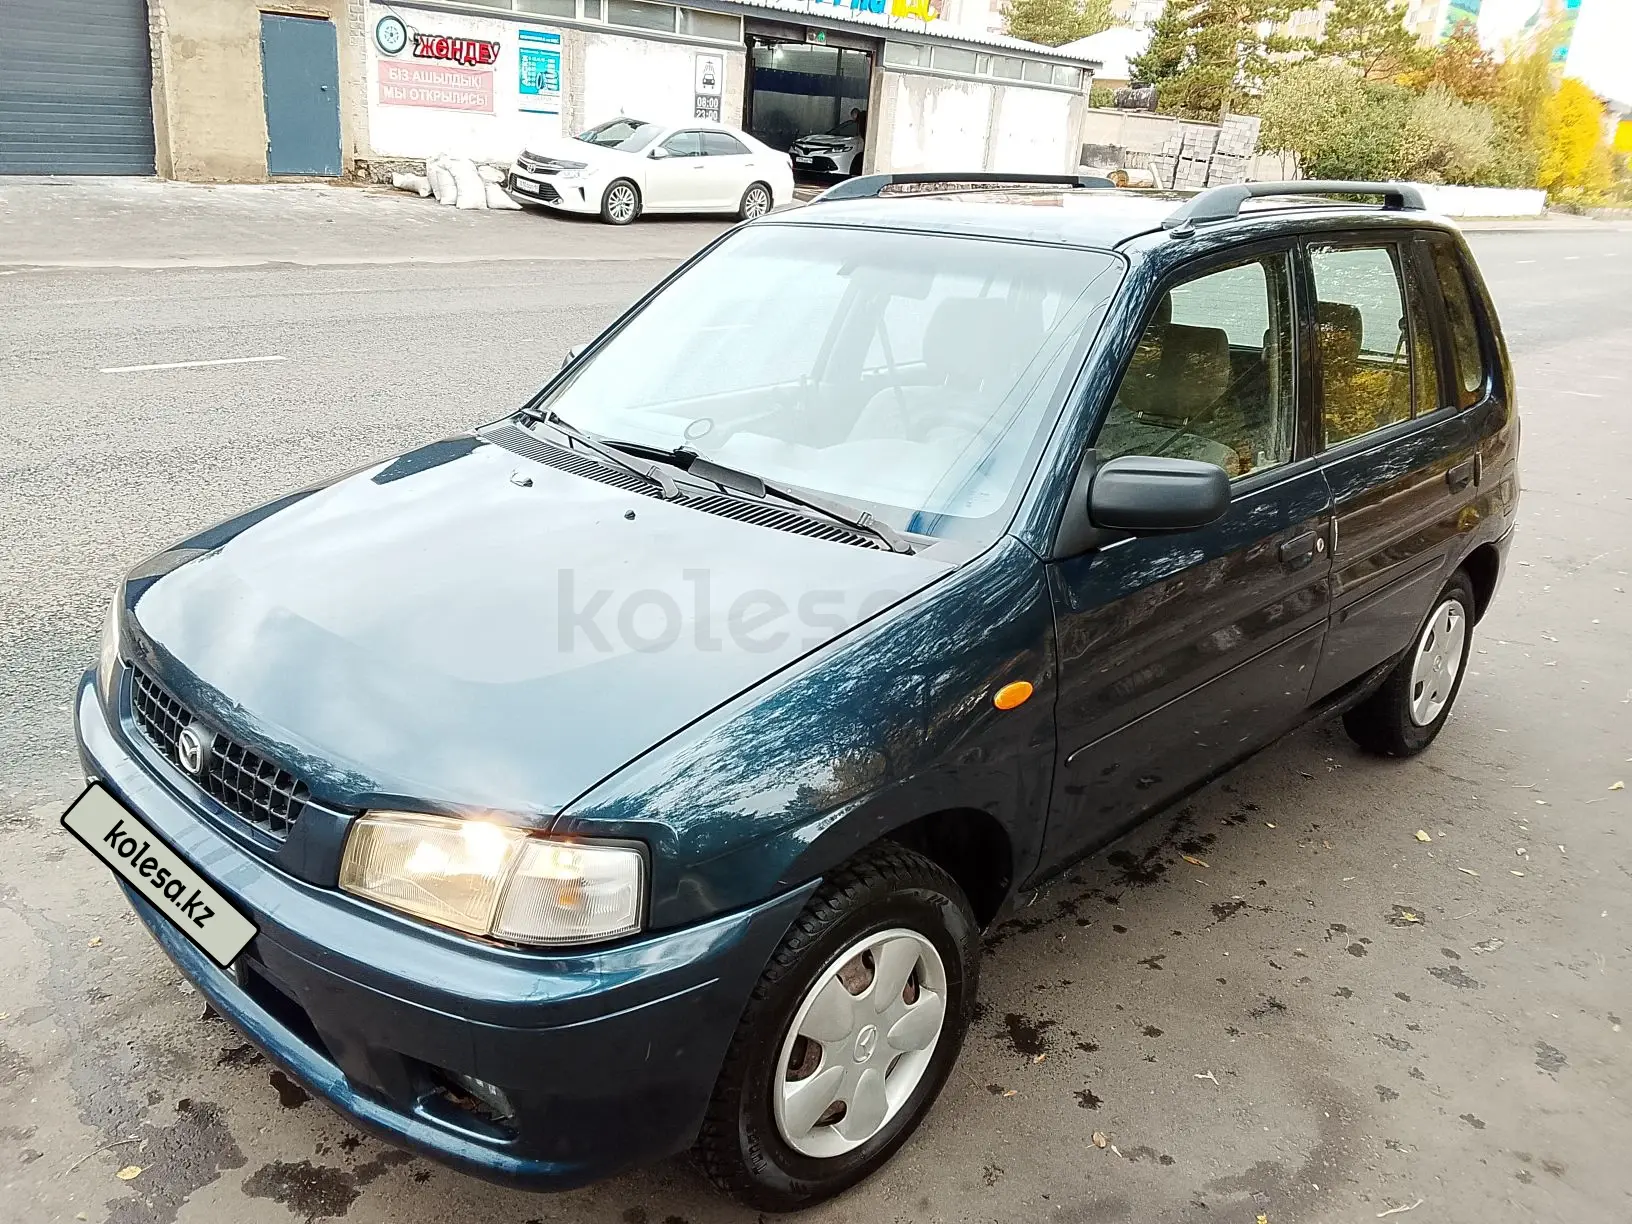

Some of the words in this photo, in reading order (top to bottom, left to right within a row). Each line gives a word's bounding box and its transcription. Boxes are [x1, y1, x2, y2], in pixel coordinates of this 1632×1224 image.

[389, 68, 409, 82] БІЗ
[383, 85, 406, 100] МЫ
[697, 96, 718, 108] 08:00
